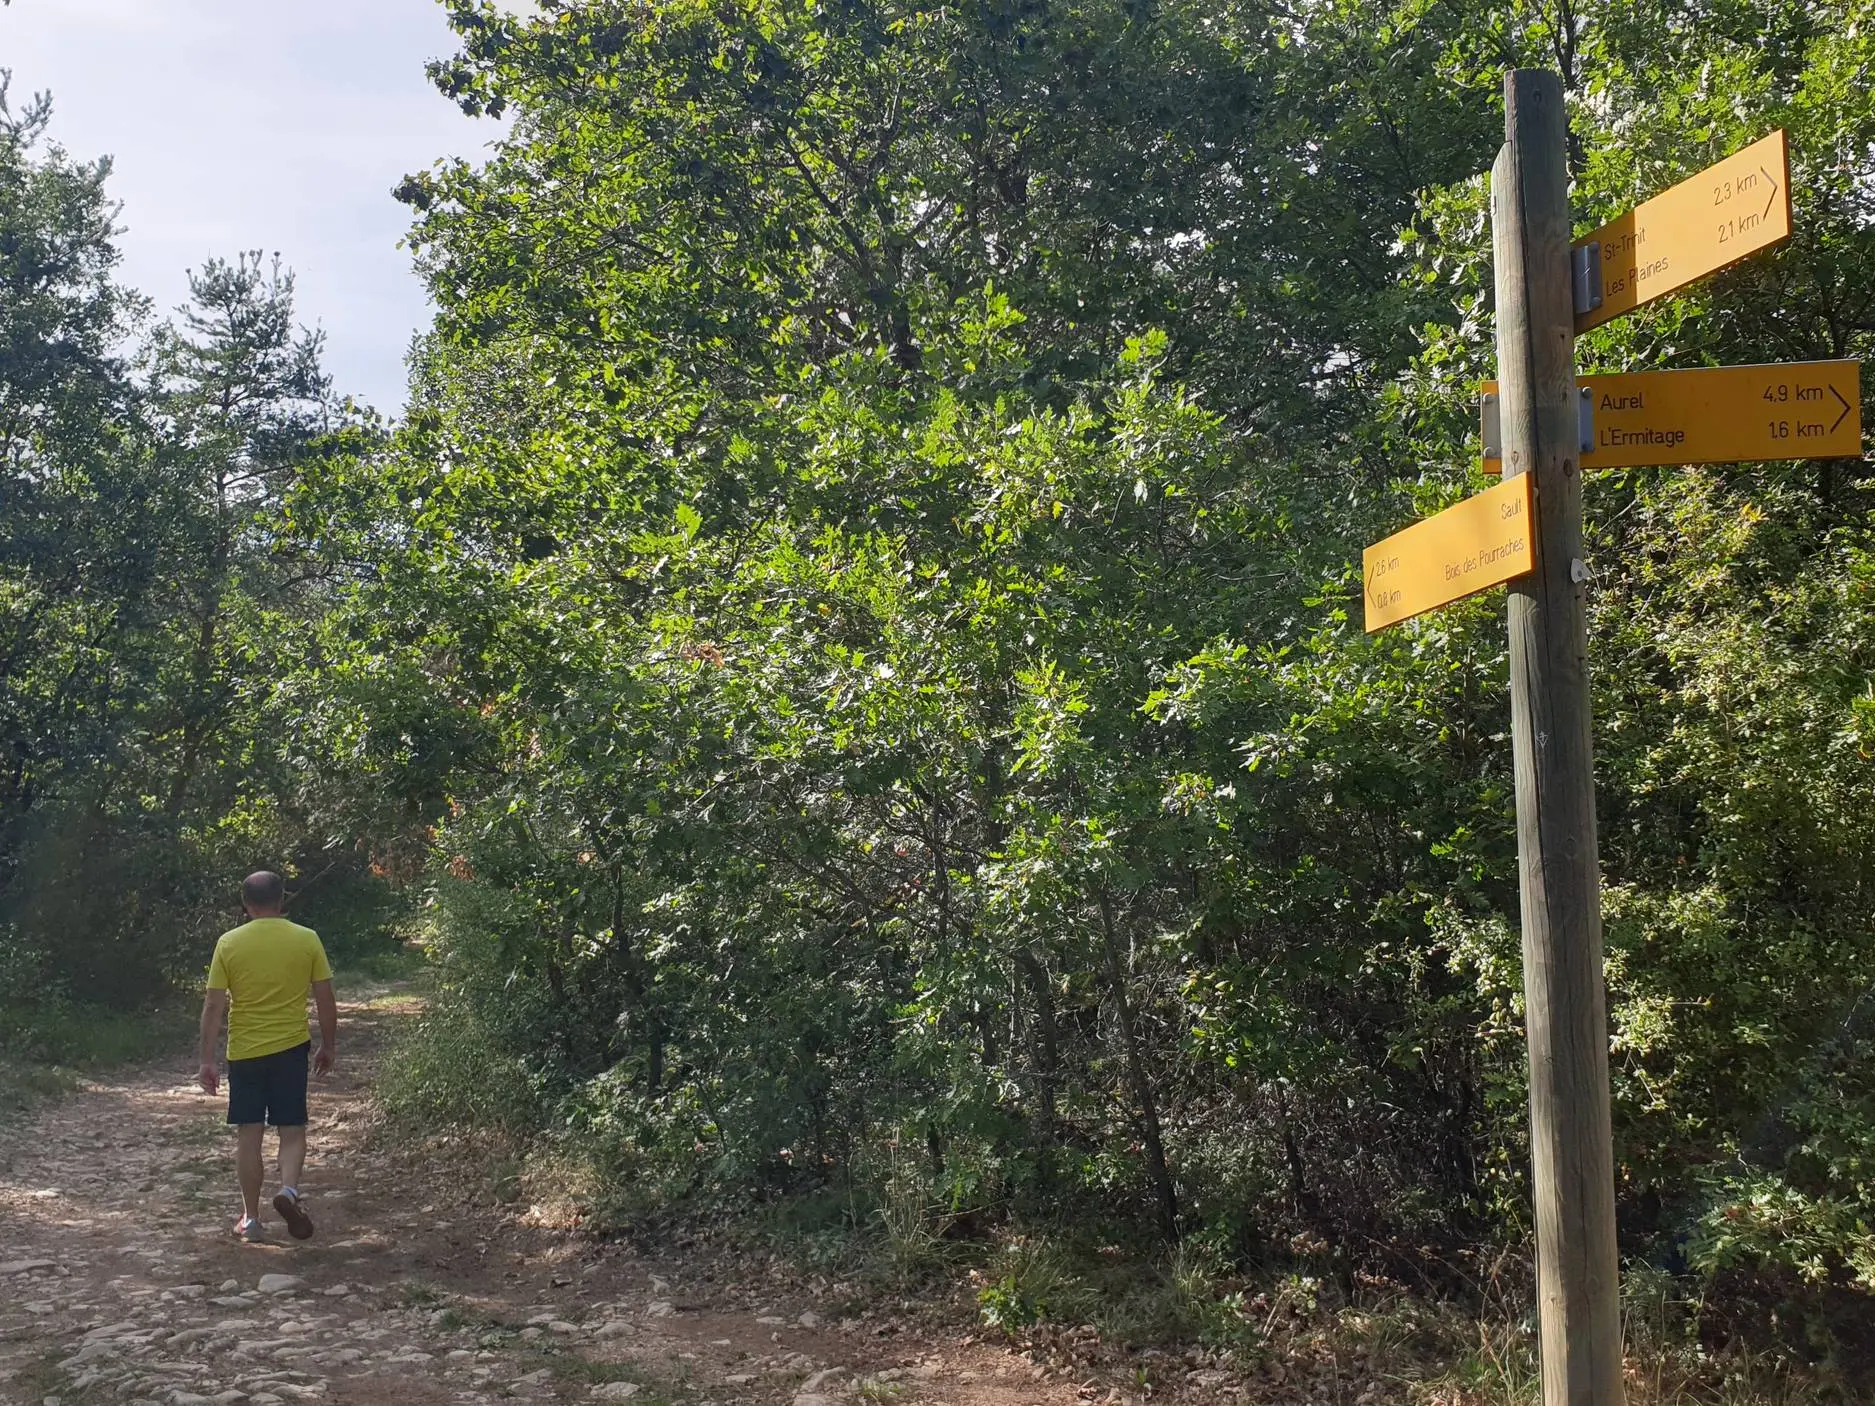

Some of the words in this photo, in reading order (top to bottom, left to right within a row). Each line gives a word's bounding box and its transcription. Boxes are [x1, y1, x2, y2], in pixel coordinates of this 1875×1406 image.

[1736, 174, 1758, 195] km
[1739, 213, 1760, 233] km
[1604, 227, 1646, 261] St-Trinit
[1605, 278, 1625, 297] Les
[1628, 257, 1669, 289] Plaines
[1600, 391, 1644, 410] Aurel
[1796, 384, 1823, 401] km
[1600, 427, 1685, 448] L'Ermitage
[1797, 420, 1825, 438] km
[1387, 556, 1400, 571] km
[1445, 564, 1461, 581] Bois
[1463, 556, 1477, 573] des
[1389, 588, 1401, 604] km
